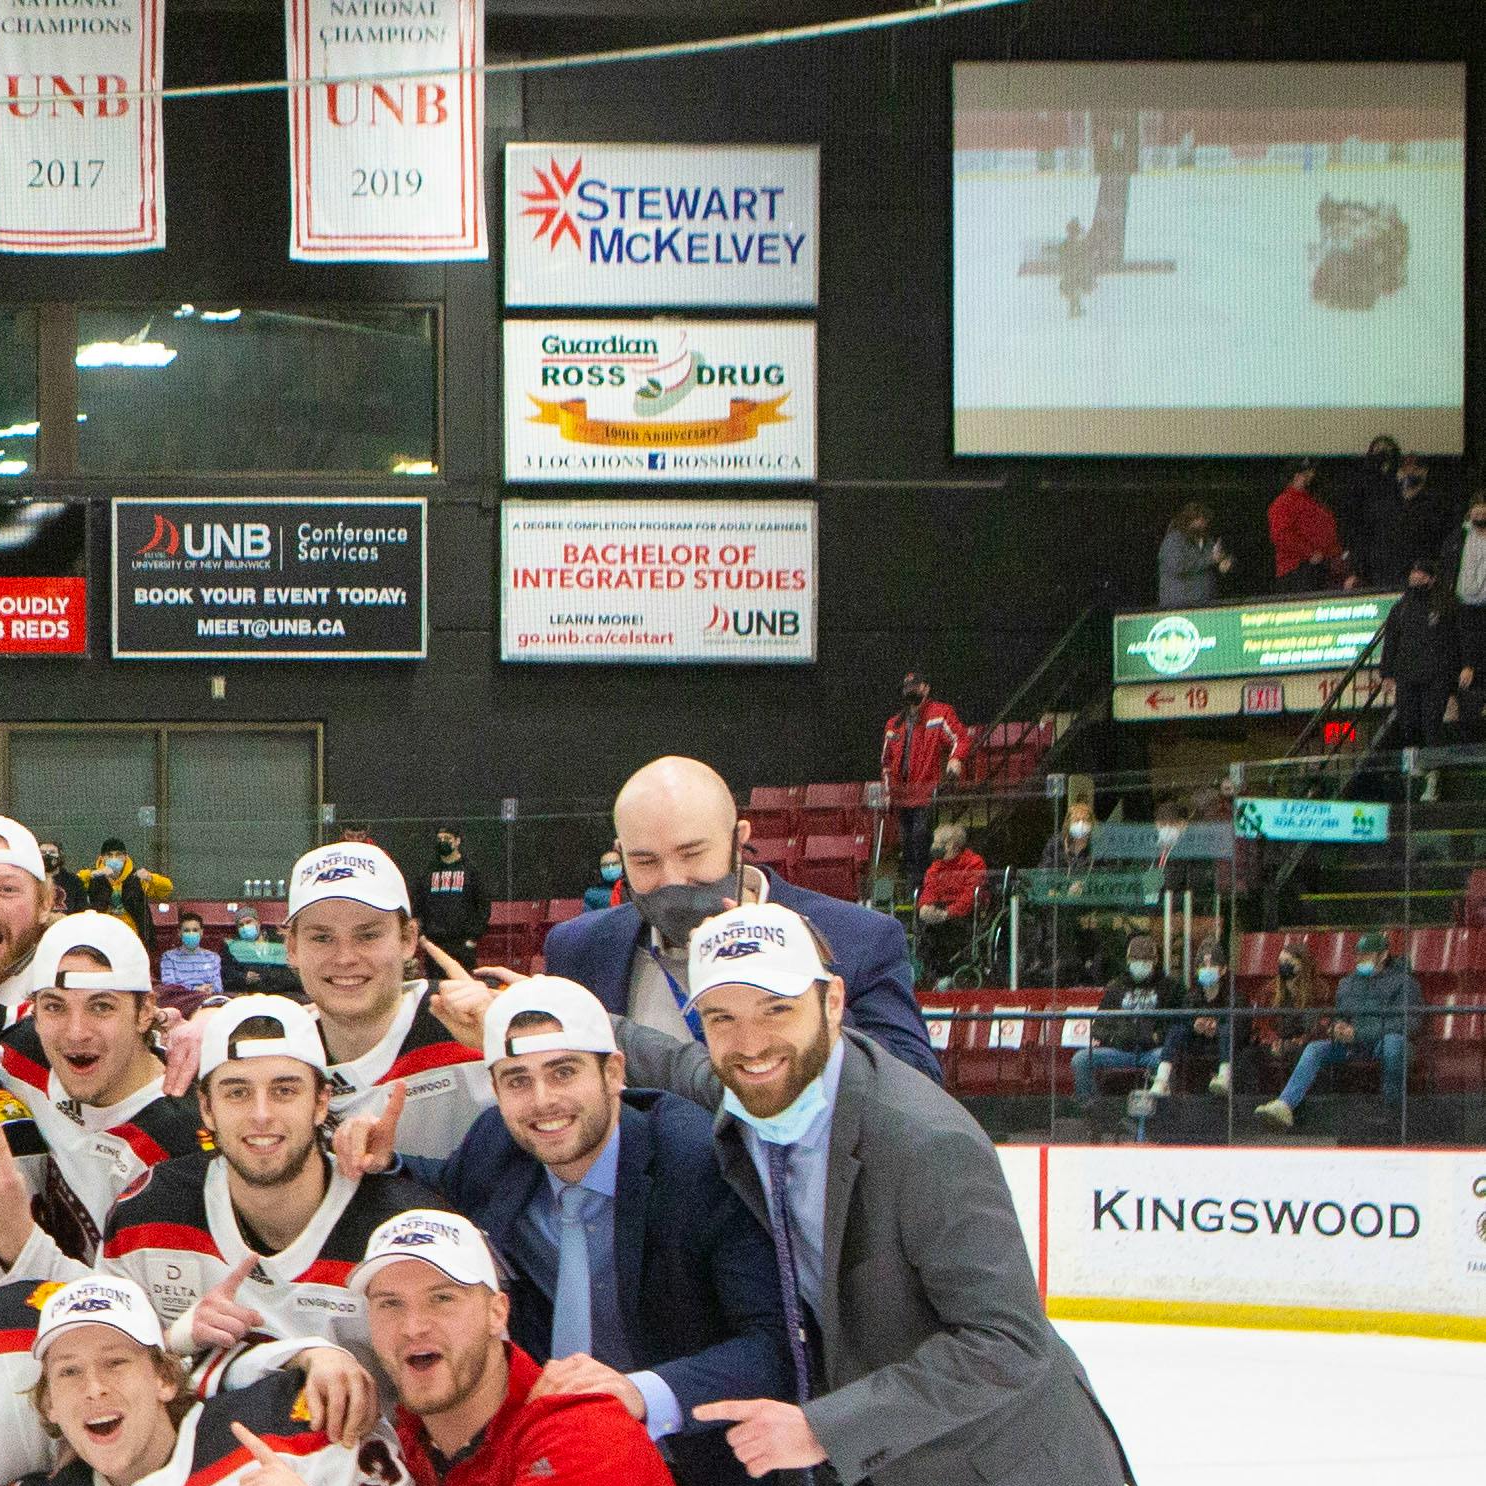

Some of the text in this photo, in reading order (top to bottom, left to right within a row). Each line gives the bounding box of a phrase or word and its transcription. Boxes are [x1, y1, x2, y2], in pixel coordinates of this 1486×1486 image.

[330, 0, 441, 18] NATIONAL
[0, 16, 133, 36] CHAMPIONS
[6, 73, 129, 119] UNB
[325, 82, 448, 128] UNB
[26, 159, 106, 188] 2017
[351, 168, 423, 198] 2019
[577, 178, 785, 222] STEWART
[541, 334, 659, 355] Guardian
[541, 364, 786, 387] ROSS DRUG
[643, 426, 721, 444] Anniversary
[538, 454, 802, 470] LOCATIONS ROSSDRUG.CA
[523, 521, 565, 532] DEGREE
[566, 521, 638, 532] COMPLETION
[639, 521, 694, 532] PROGRAM
[183, 521, 409, 560] UNB Conference
[297, 543, 379, 563] Services
[563, 543, 757, 567] BACHELOR OF
[512, 567, 807, 592] INTEGRATED STUDIES
[134, 588, 193, 606] BOOK
[199, 588, 257, 606] YOUR
[264, 588, 331, 606] EVENT
[10, 620, 70, 640] REDS
[197, 618, 347, 637] MEET@UNB.CA
[549, 614, 645, 627] LEARN MORE!
[732, 609, 801, 637] UNB
[517, 630, 675, 649] go.unb.ca/celstart
[1185, 687, 1209, 711] 19
[693, 925, 786, 957] CHAMPIONS
[1092, 1188, 1423, 1239] KINGSWOOD
[152, 1283, 198, 1298] DELTA
